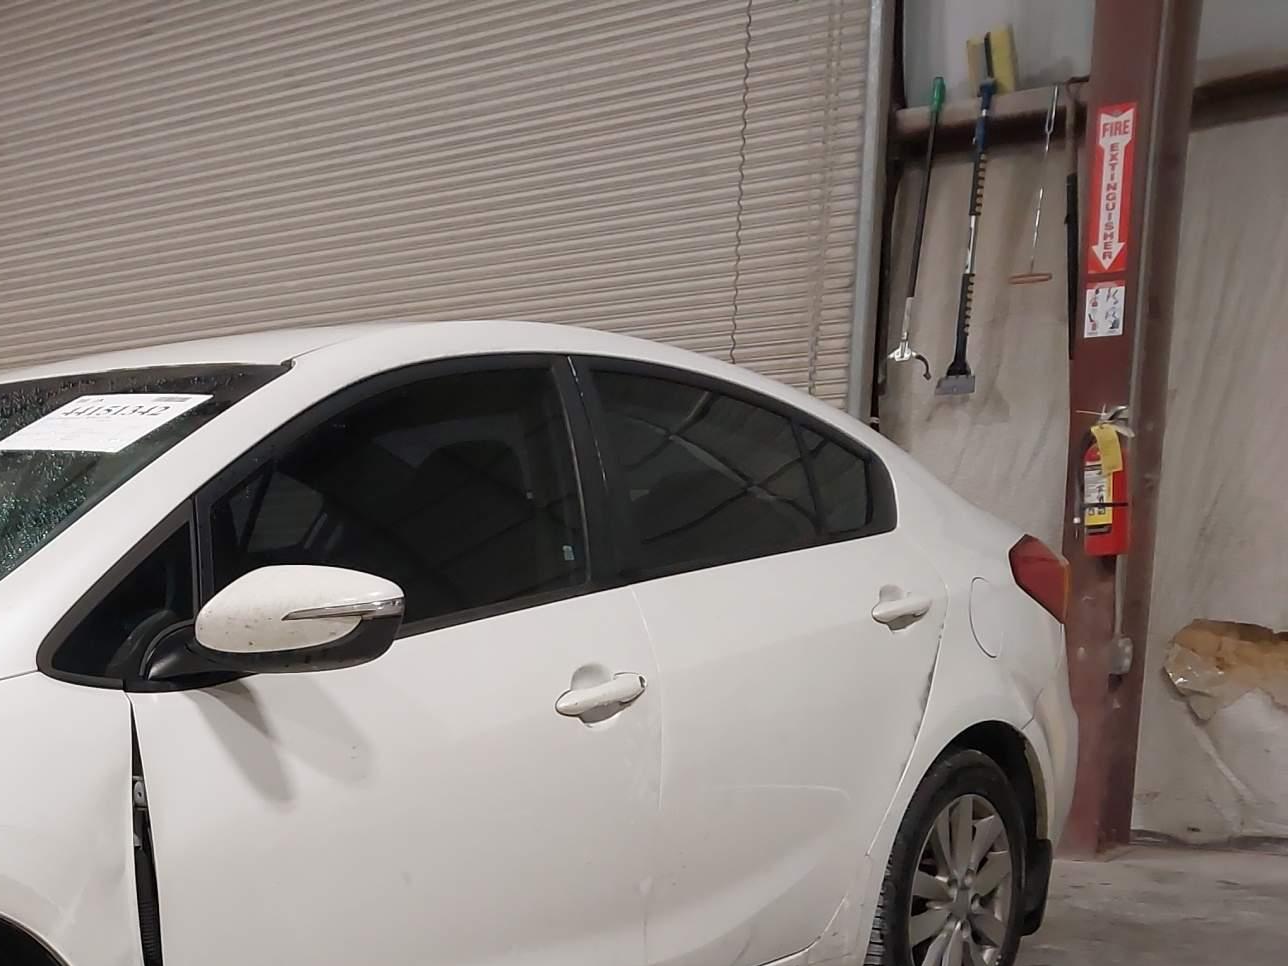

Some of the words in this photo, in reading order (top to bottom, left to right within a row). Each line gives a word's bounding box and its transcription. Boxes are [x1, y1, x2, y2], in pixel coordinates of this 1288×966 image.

[1102, 119, 1130, 138] FIRE
[1101, 142, 1120, 260] EXTINGUISHER
[62, 405, 171, 416] 44151342
